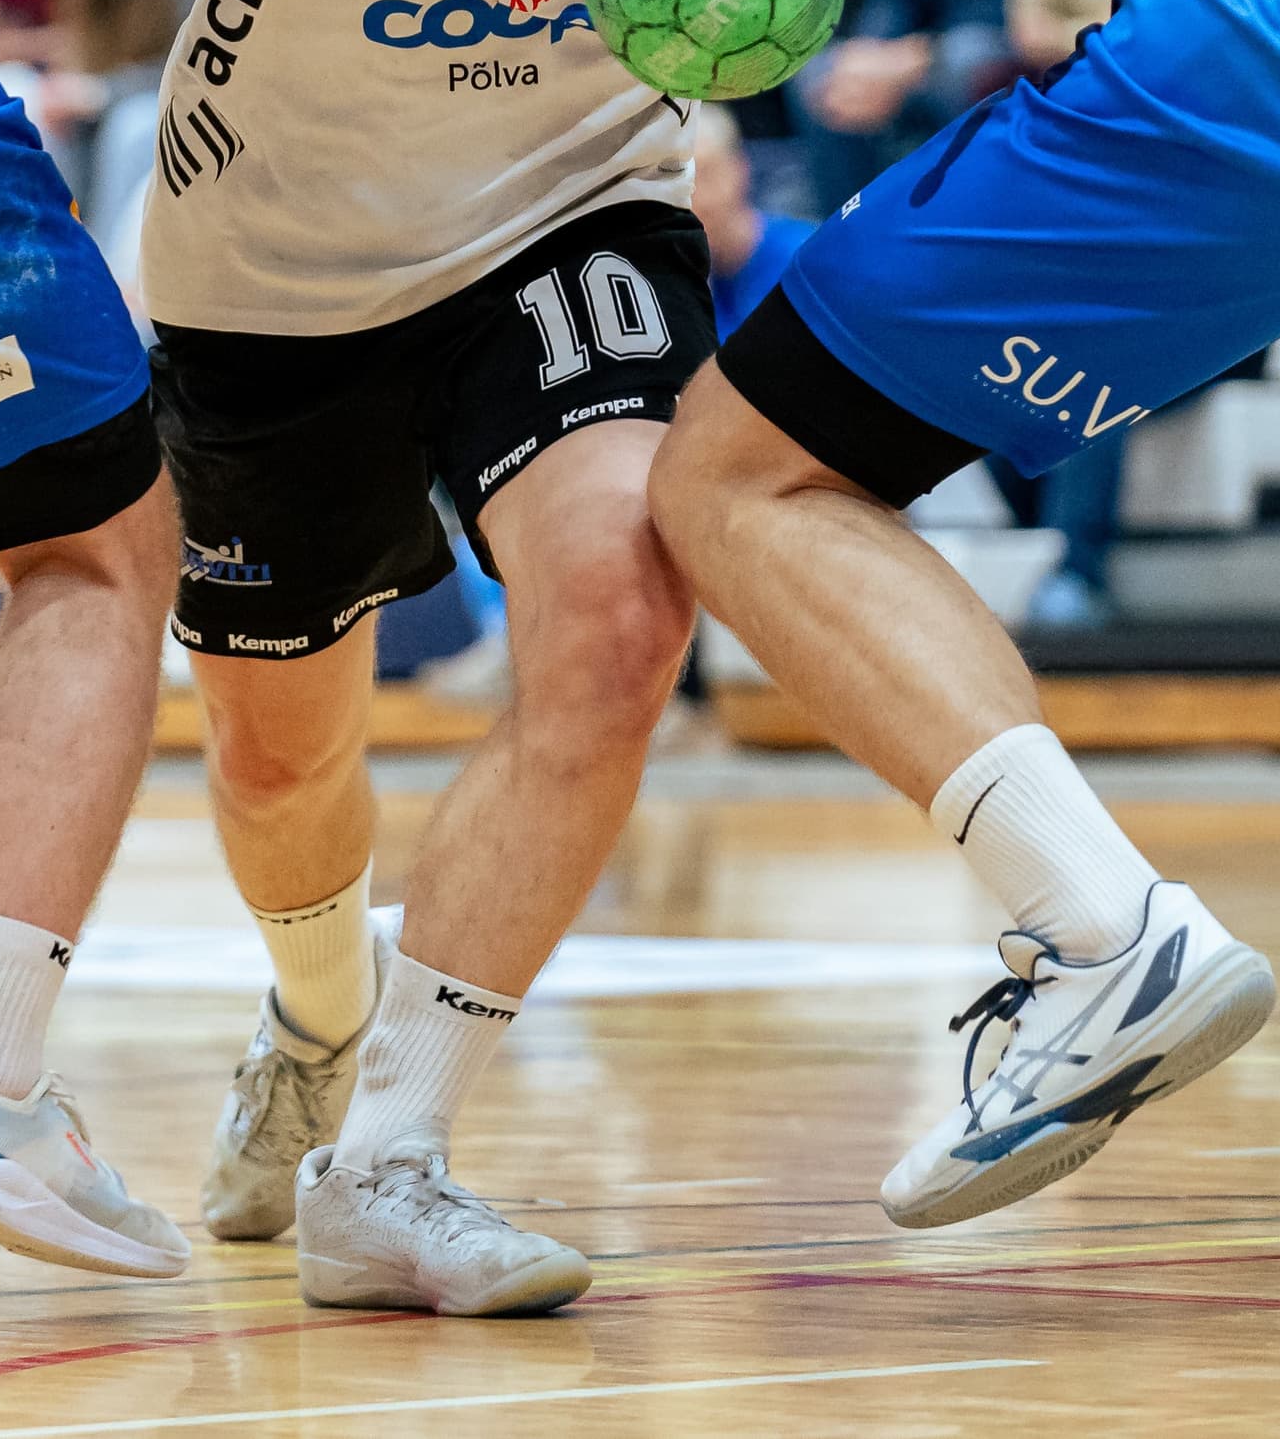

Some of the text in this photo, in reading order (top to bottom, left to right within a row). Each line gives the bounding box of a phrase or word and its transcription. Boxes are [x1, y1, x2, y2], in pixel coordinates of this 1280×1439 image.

[448, 60, 539, 92] Põlva
[516, 251, 672, 391] 10
[562, 397, 644, 429] Kempa
[478, 436, 537, 492] Kempa
[333, 587, 398, 633] Kempa
[228, 633, 309, 655] Kempa
